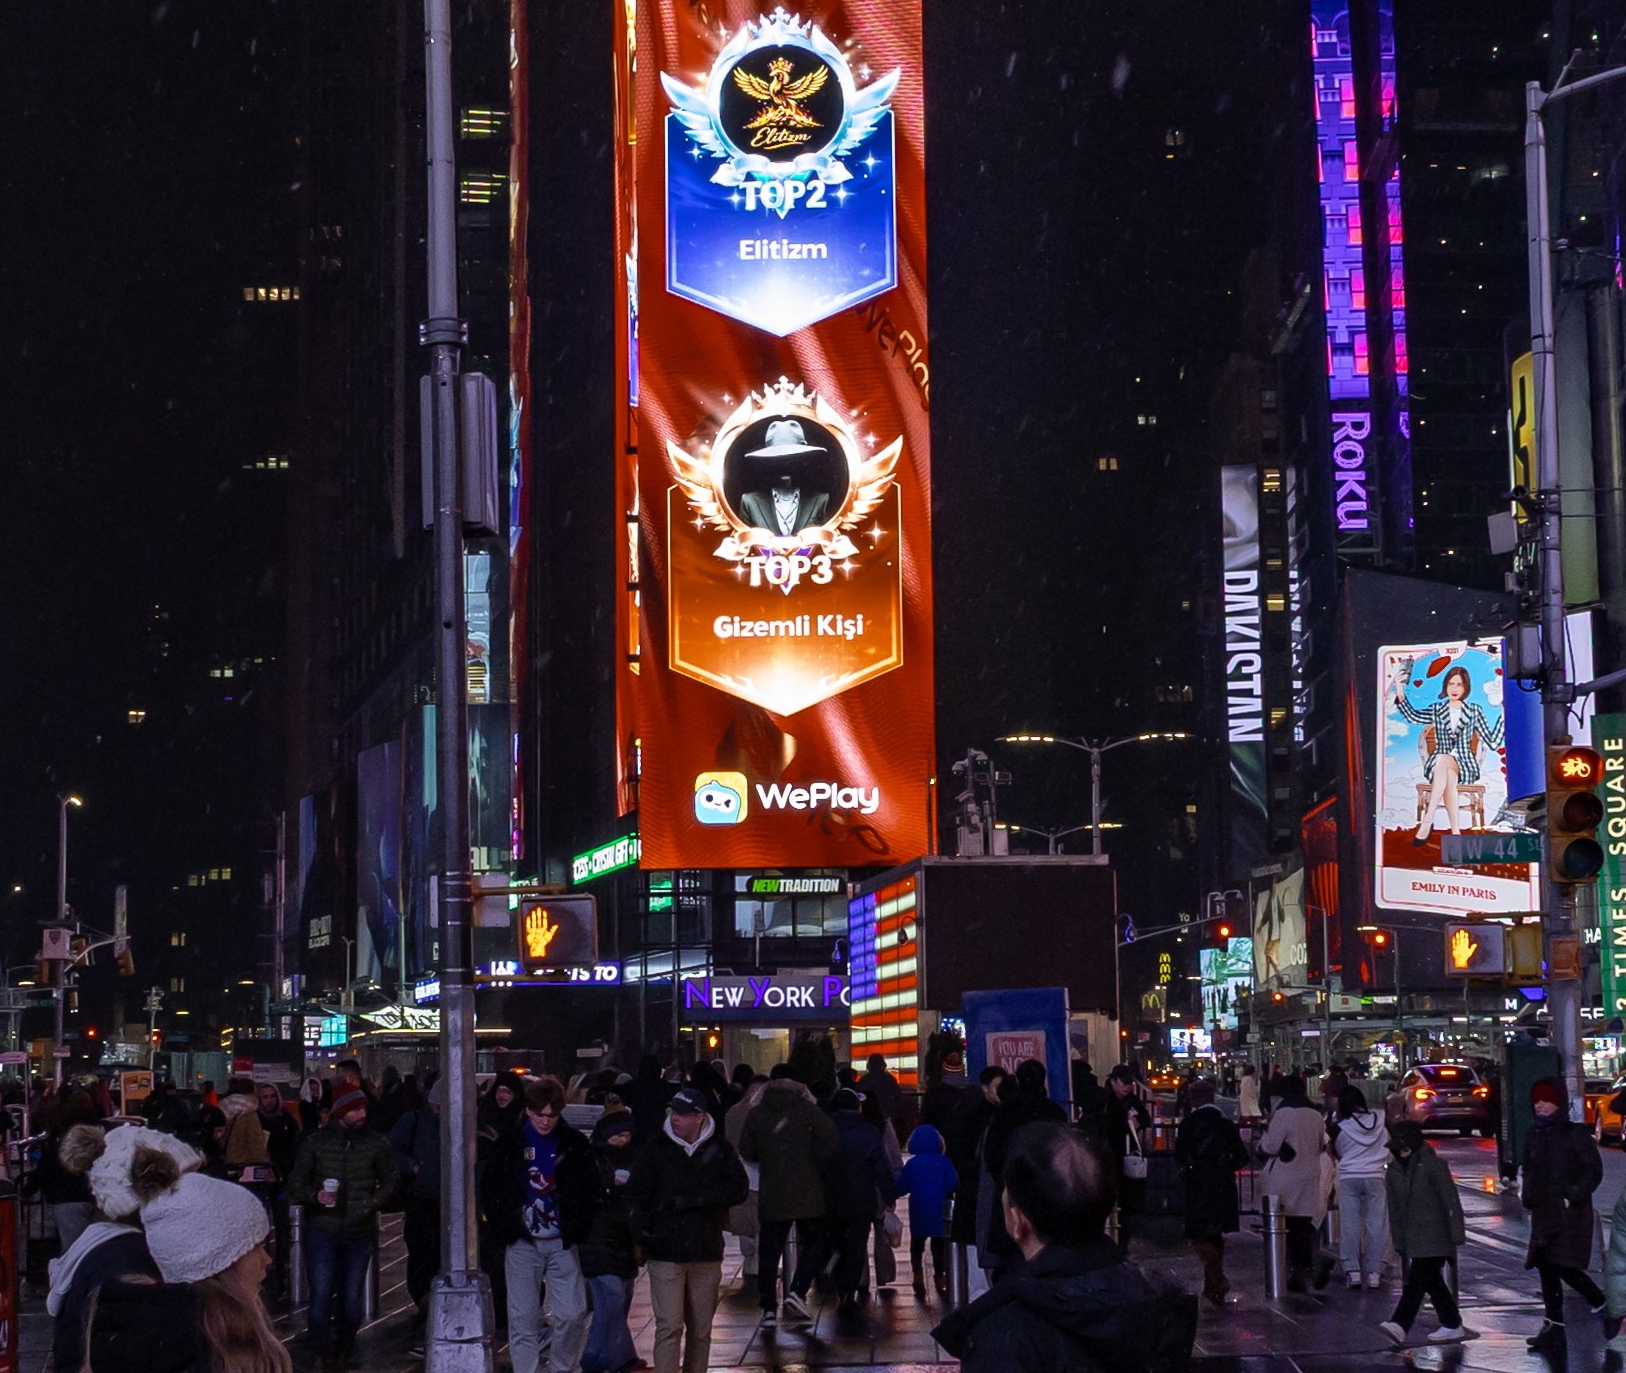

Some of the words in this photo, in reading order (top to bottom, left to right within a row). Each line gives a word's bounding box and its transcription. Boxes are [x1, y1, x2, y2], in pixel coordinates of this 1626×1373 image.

[750, 127, 812, 150] Elitizm
[739, 179, 827, 210] TOP2
[739, 238, 828, 261] Elitizm
[744, 554, 833, 587] TOP3
[713, 614, 811, 639] Gizemli
[817, 613, 864, 641] Kişi
[756, 781, 880, 815] WePlay
[1466, 838, 1483, 860] W
[1493, 837, 1519, 860] 44
[1411, 880, 1446, 896] EMILY
[1447, 884, 1460, 896] IN
[1462, 886, 1497, 901] PARIS
[685, 977, 745, 1010] NEW
[748, 977, 816, 1009] YORK
[1018, 1041, 1034, 1057] ARE
